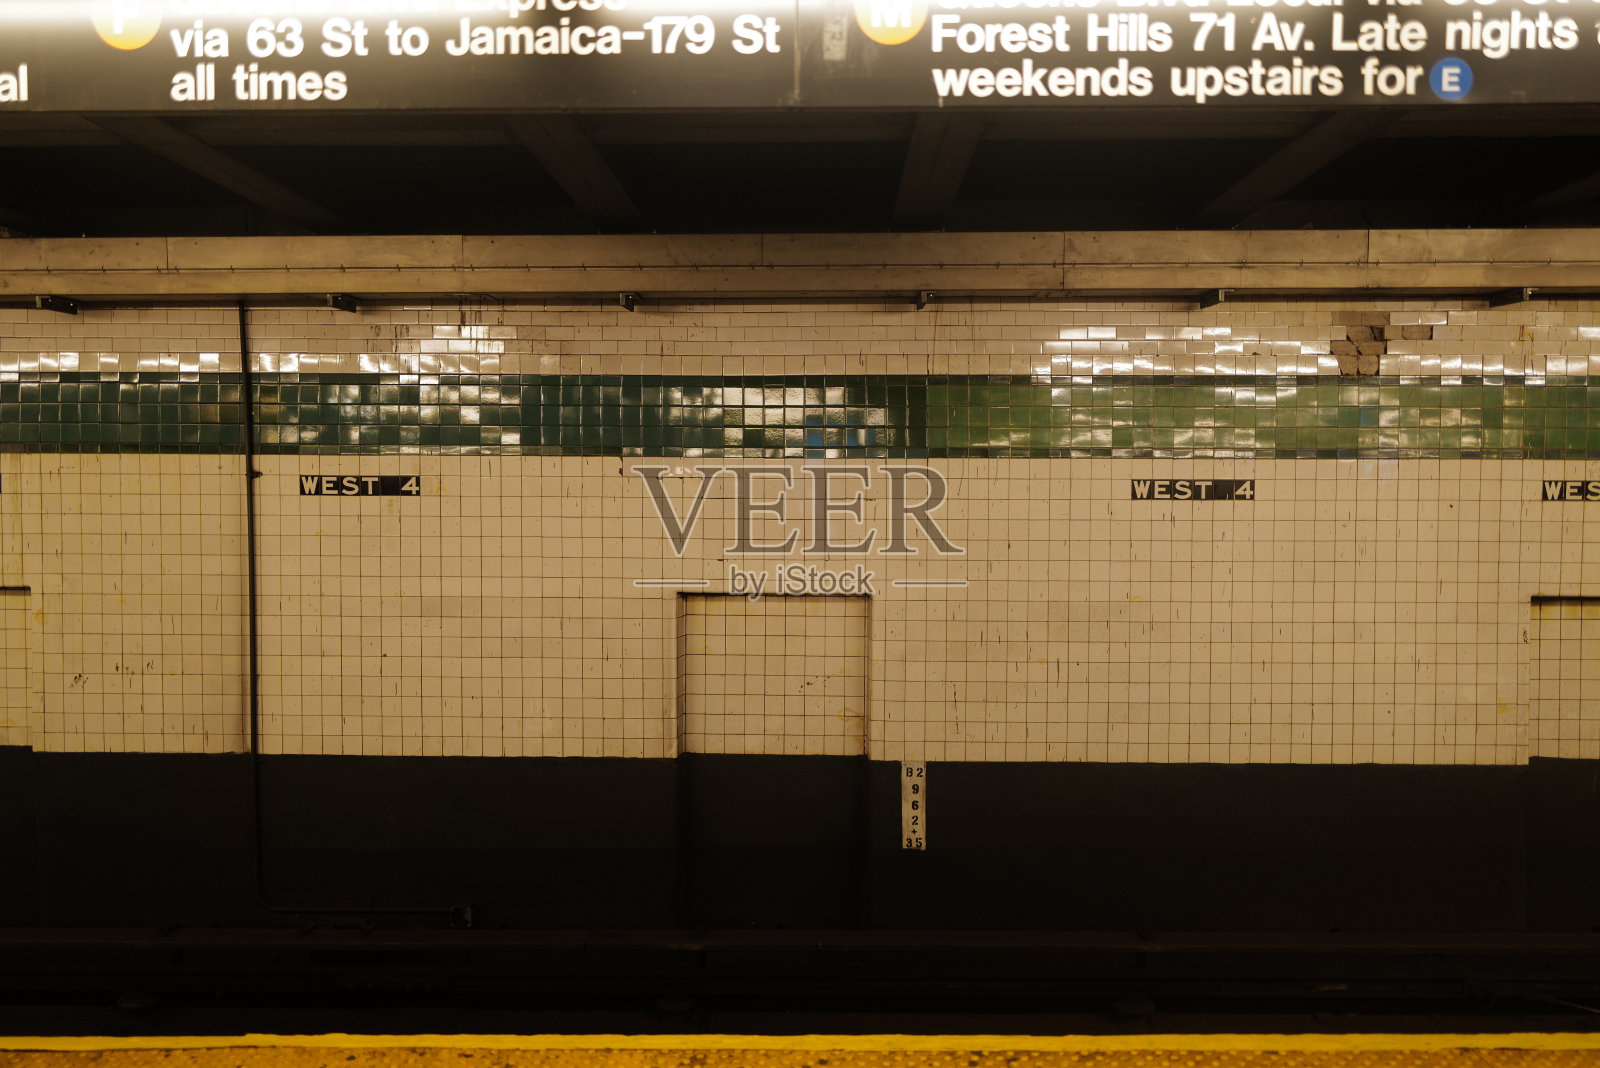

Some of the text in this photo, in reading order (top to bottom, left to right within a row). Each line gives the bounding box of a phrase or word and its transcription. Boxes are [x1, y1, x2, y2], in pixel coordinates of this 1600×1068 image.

[870, 0, 913, 28] M
[169, 19, 229, 58] via
[246, 18, 304, 58] 63
[321, 16, 369, 57] St
[385, 19, 430, 57] to
[445, 14, 716, 57] Jamaica-179
[731, 13, 781, 55] St
[931, 13, 1071, 53] Forest
[1087, 12, 1174, 52] Hills
[1189, 12, 1237, 52] 71
[1251, 11, 1316, 52] Av.
[1331, 11, 1429, 51] Late
[1445, 8, 1580, 60] nights
[170, 62, 348, 102] all times
[931, 55, 1462, 104] weekends upstairs for E
[301, 476, 420, 495] WEST 4
[1133, 480, 1254, 500] WEST 4
[1544, 481, 1600, 500] WES
